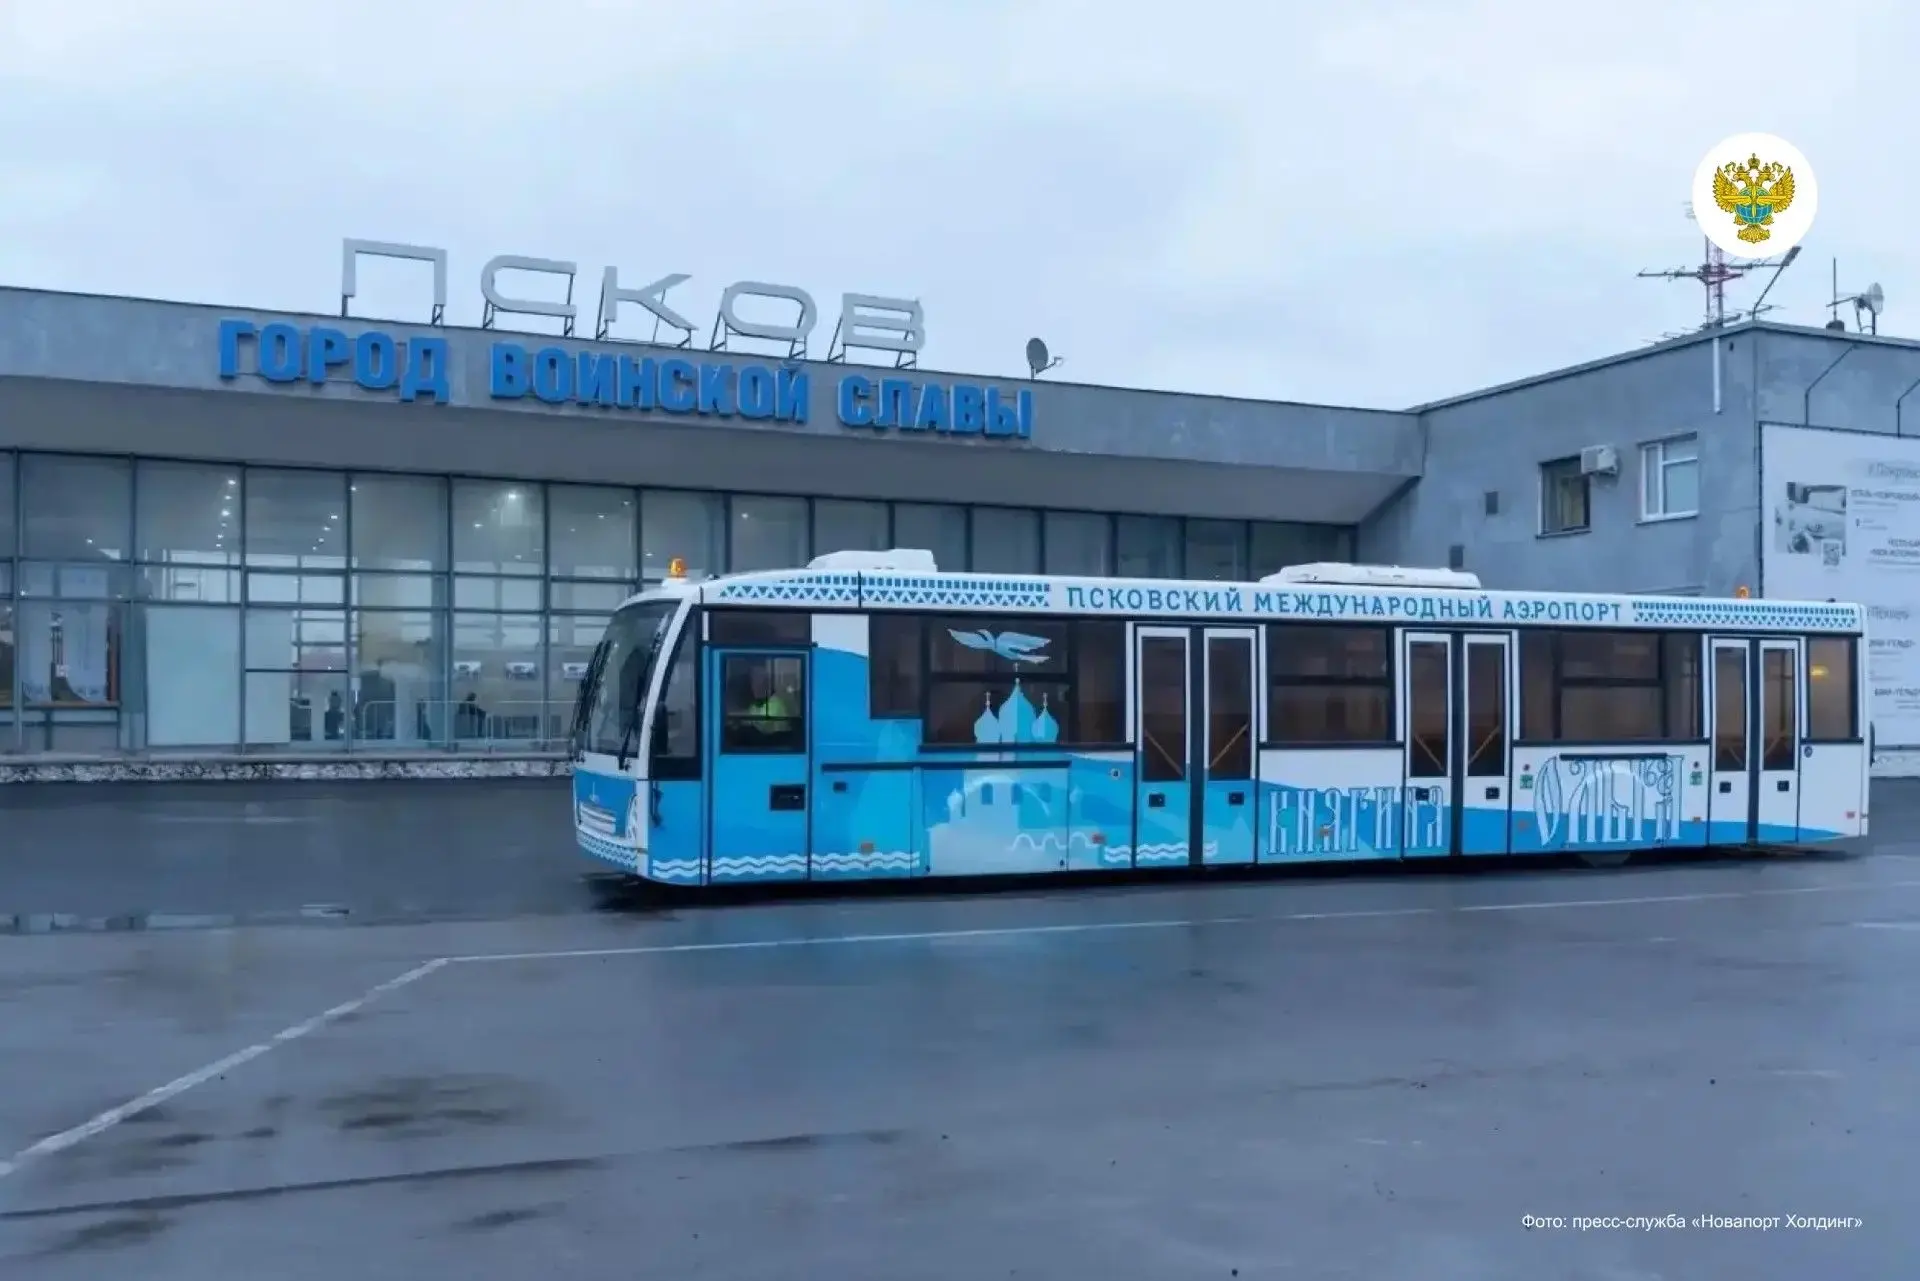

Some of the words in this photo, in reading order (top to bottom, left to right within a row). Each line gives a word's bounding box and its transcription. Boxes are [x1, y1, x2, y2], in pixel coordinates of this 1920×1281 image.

[342, 238, 926, 351] ПСКОВ
[219, 320, 449, 403] ГОРОД
[490, 340, 810, 424] ВОИНСКОЙ
[838, 374, 1033, 439] СЛАВЫ
[1068, 586, 1241, 612] ПСКОВСКИЙ
[1254, 592, 1492, 618] МЕЖДУНАРОДНЫЙ
[1503, 600, 1621, 622] АЭРОПОРТ
